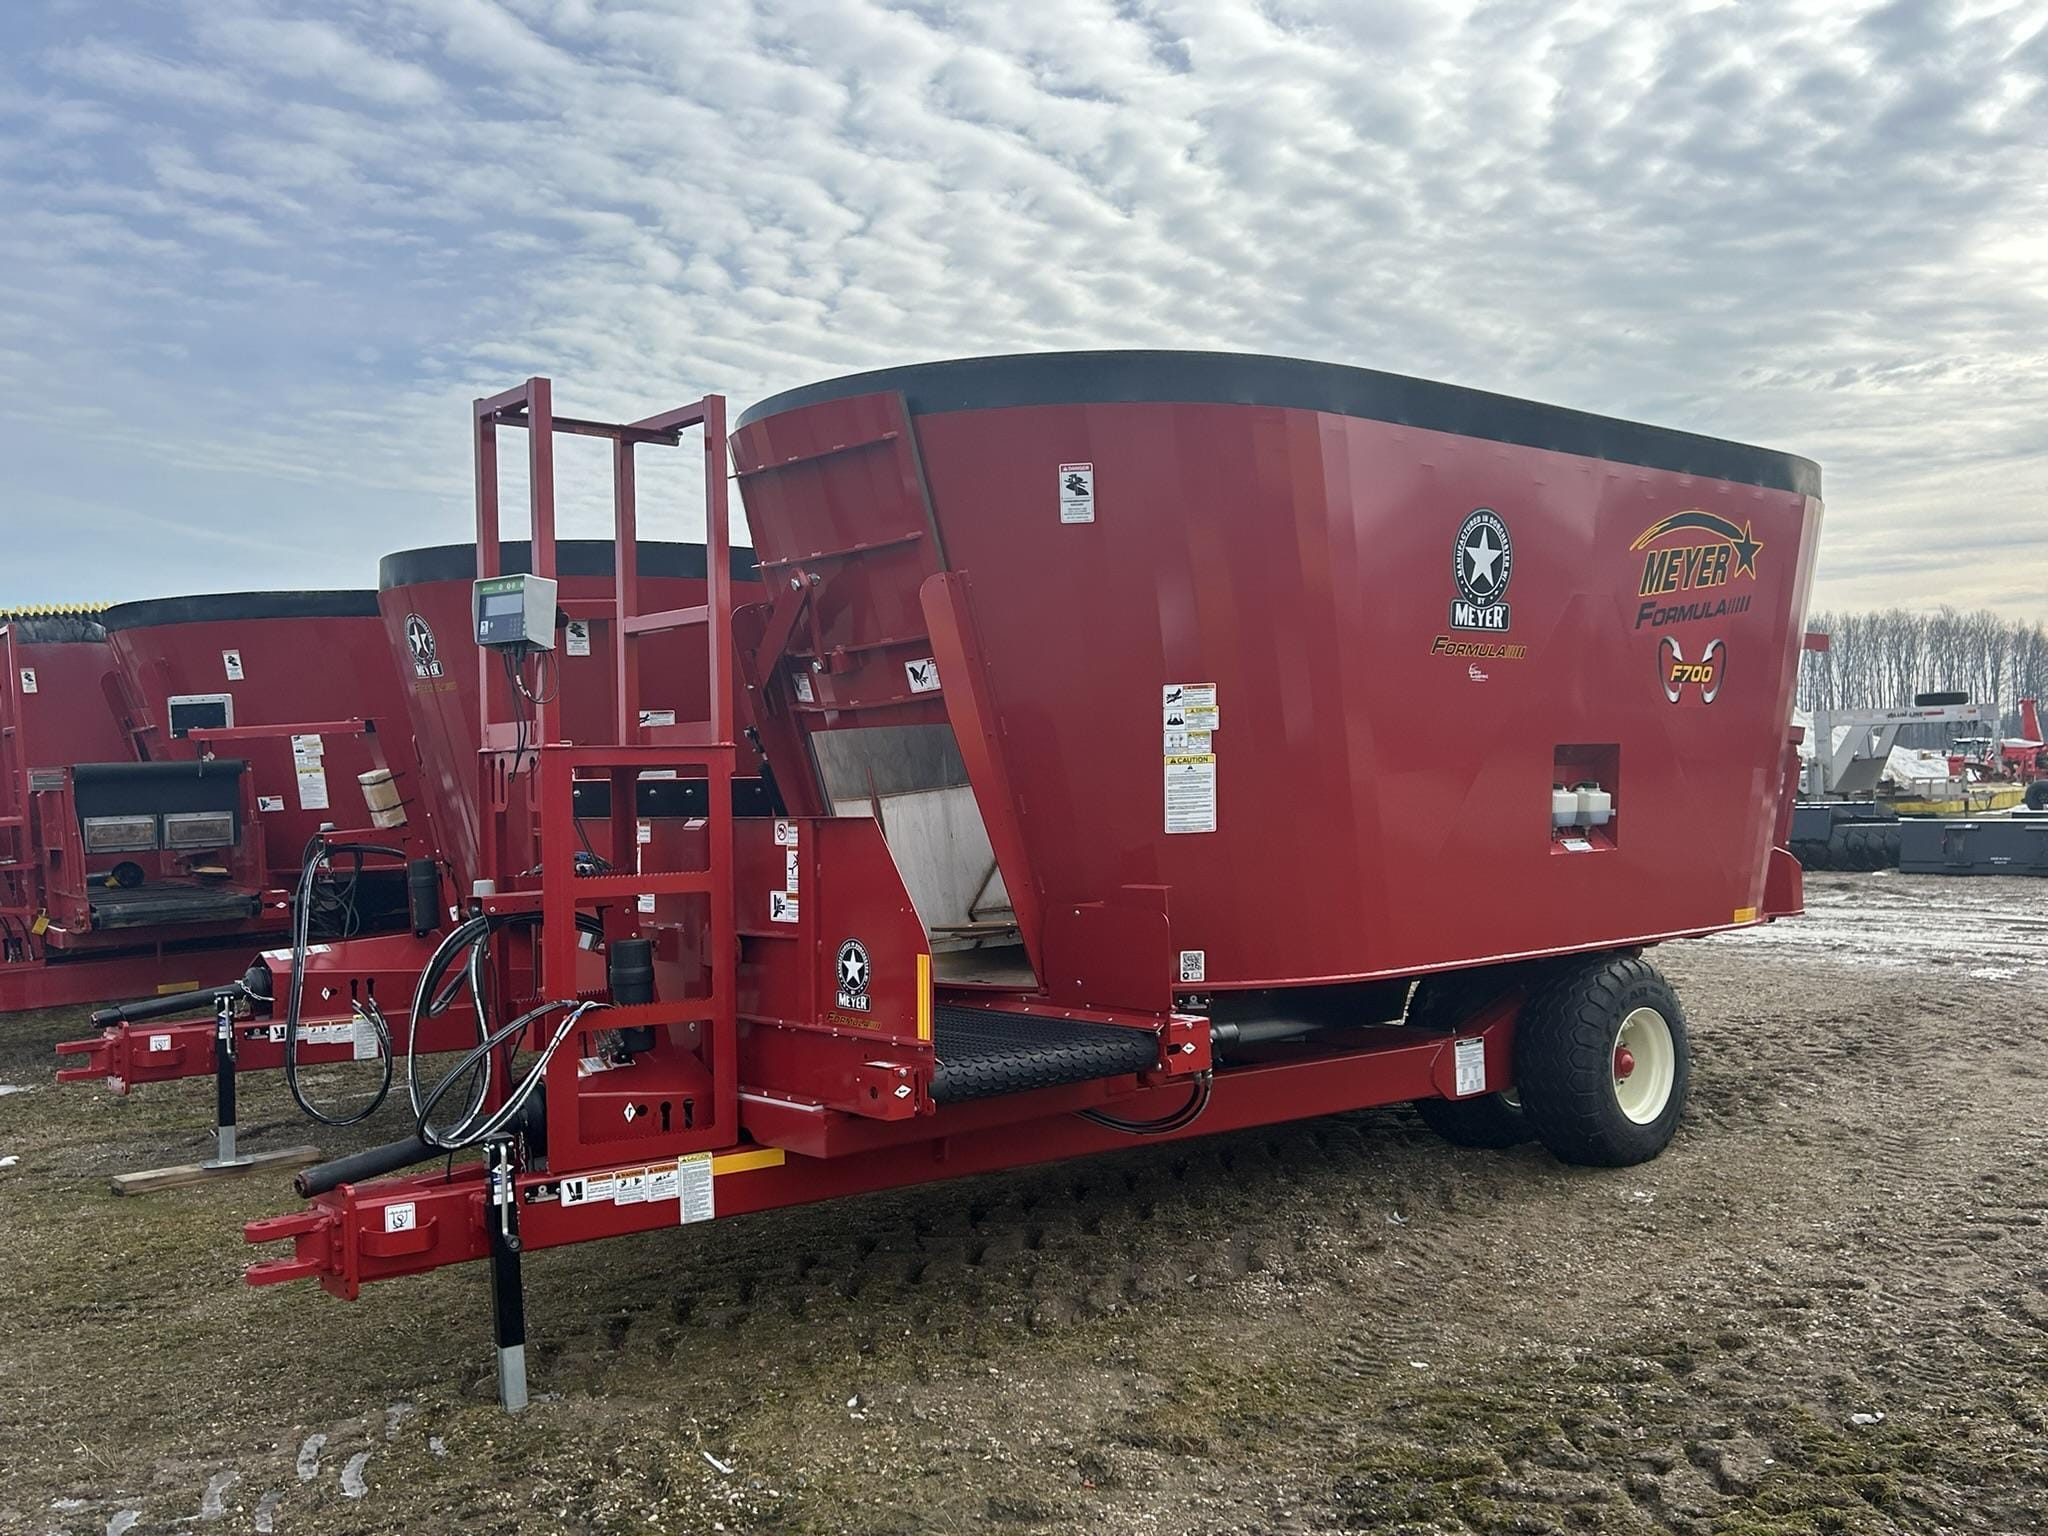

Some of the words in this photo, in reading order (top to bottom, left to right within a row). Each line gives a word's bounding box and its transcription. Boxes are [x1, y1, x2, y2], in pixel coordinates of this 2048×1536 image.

[1456, 515, 1481, 577] MANUFACTURED
[1489, 517, 1510, 567] DORCHESTER
[1639, 543, 1732, 596] MEYER
[1455, 603, 1503, 628] MEYER
[1671, 664, 1714, 683] F700
[1177, 756, 1209, 765] CAUTION
[838, 993, 867, 1009] MEYER
